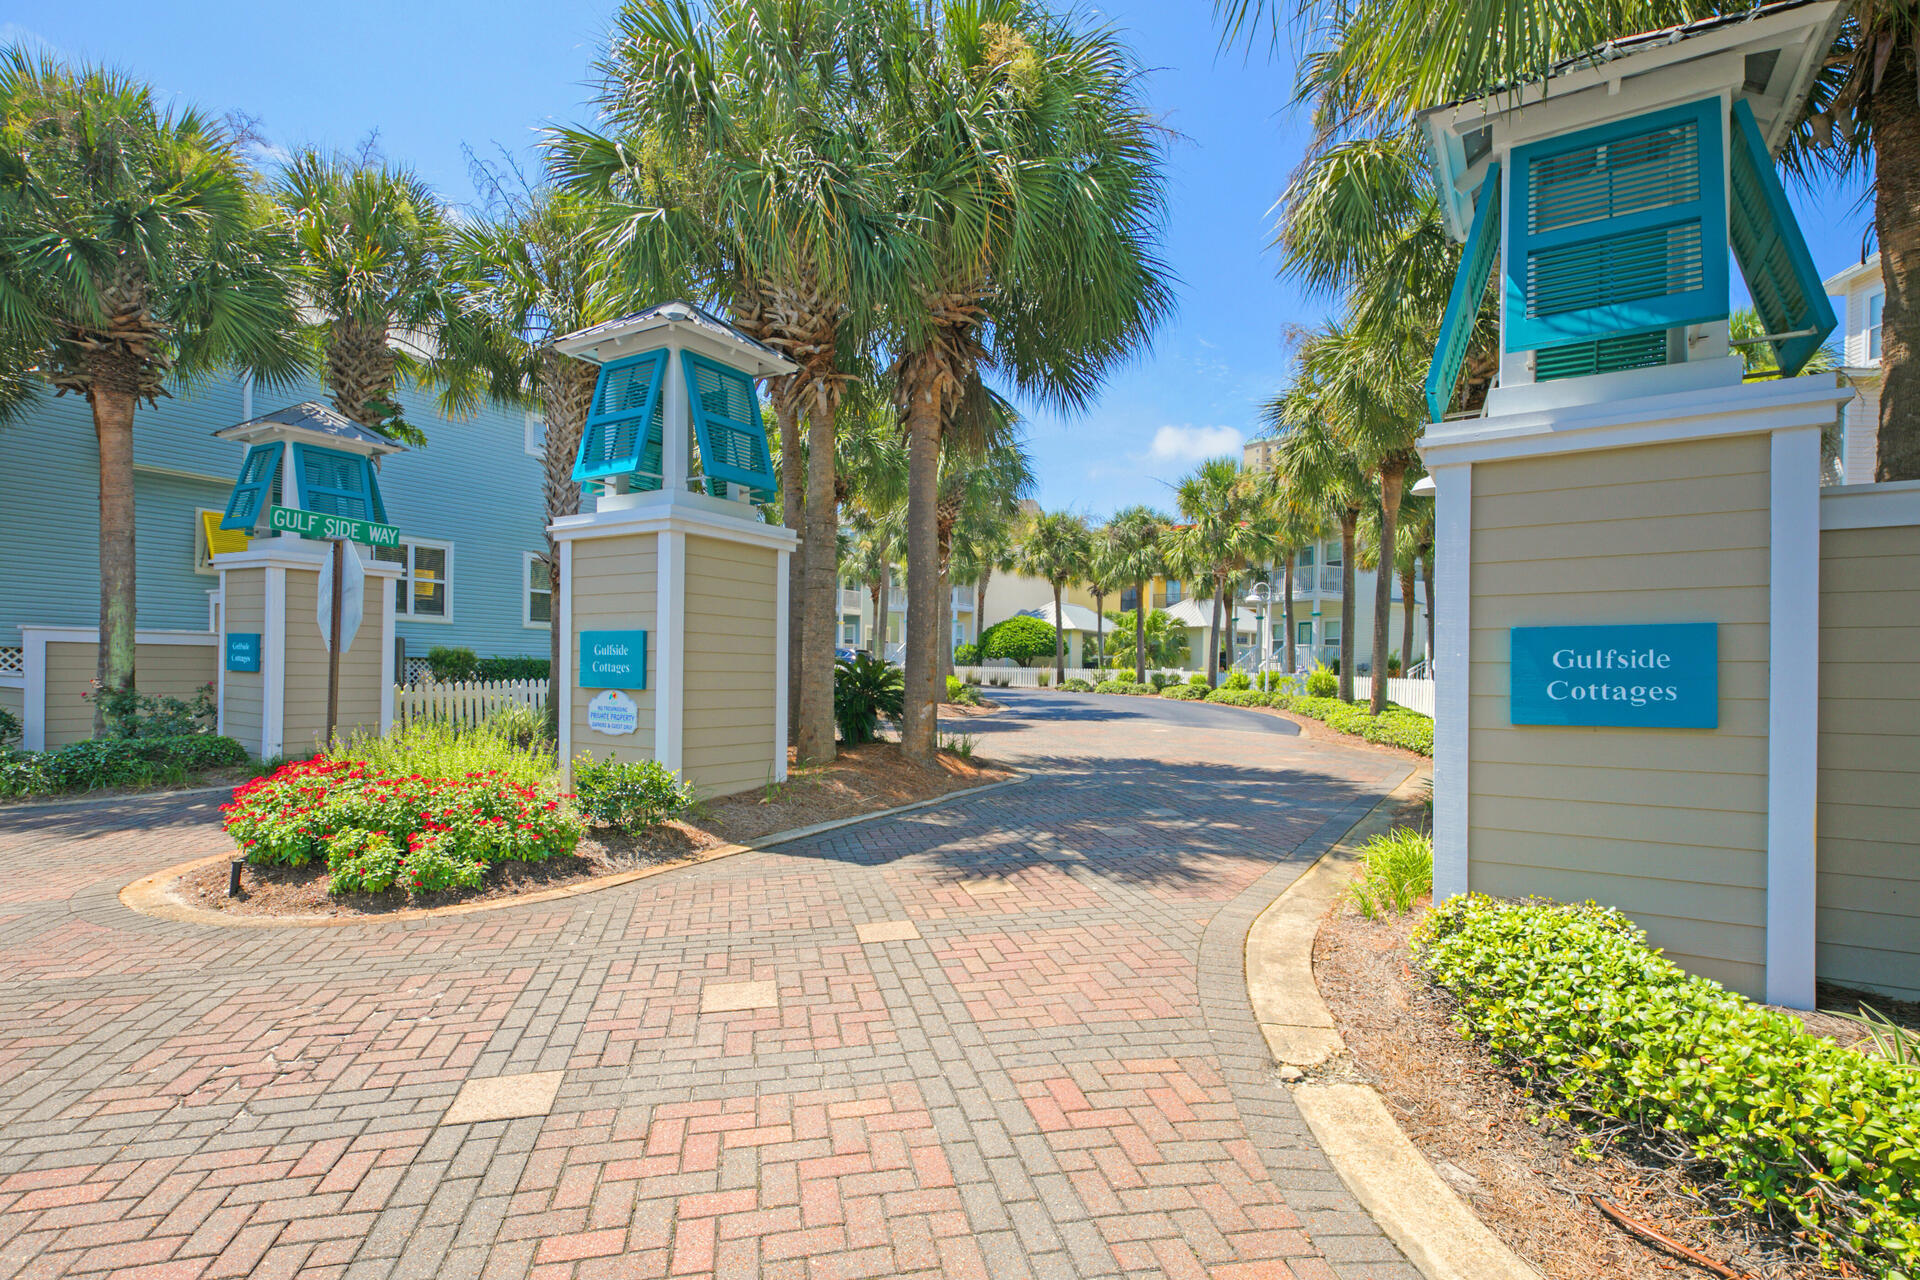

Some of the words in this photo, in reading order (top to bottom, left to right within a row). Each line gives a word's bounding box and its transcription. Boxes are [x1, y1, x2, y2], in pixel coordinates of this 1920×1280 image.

[274, 510, 319, 531] GULF
[323, 518, 361, 539] SIDE
[368, 525, 398, 545] WAY
[594, 643, 629, 656] Gulfside
[1552, 649, 1671, 669] Gulfside
[592, 661, 630, 674] Cottages
[1546, 680, 1678, 707] Cottages
